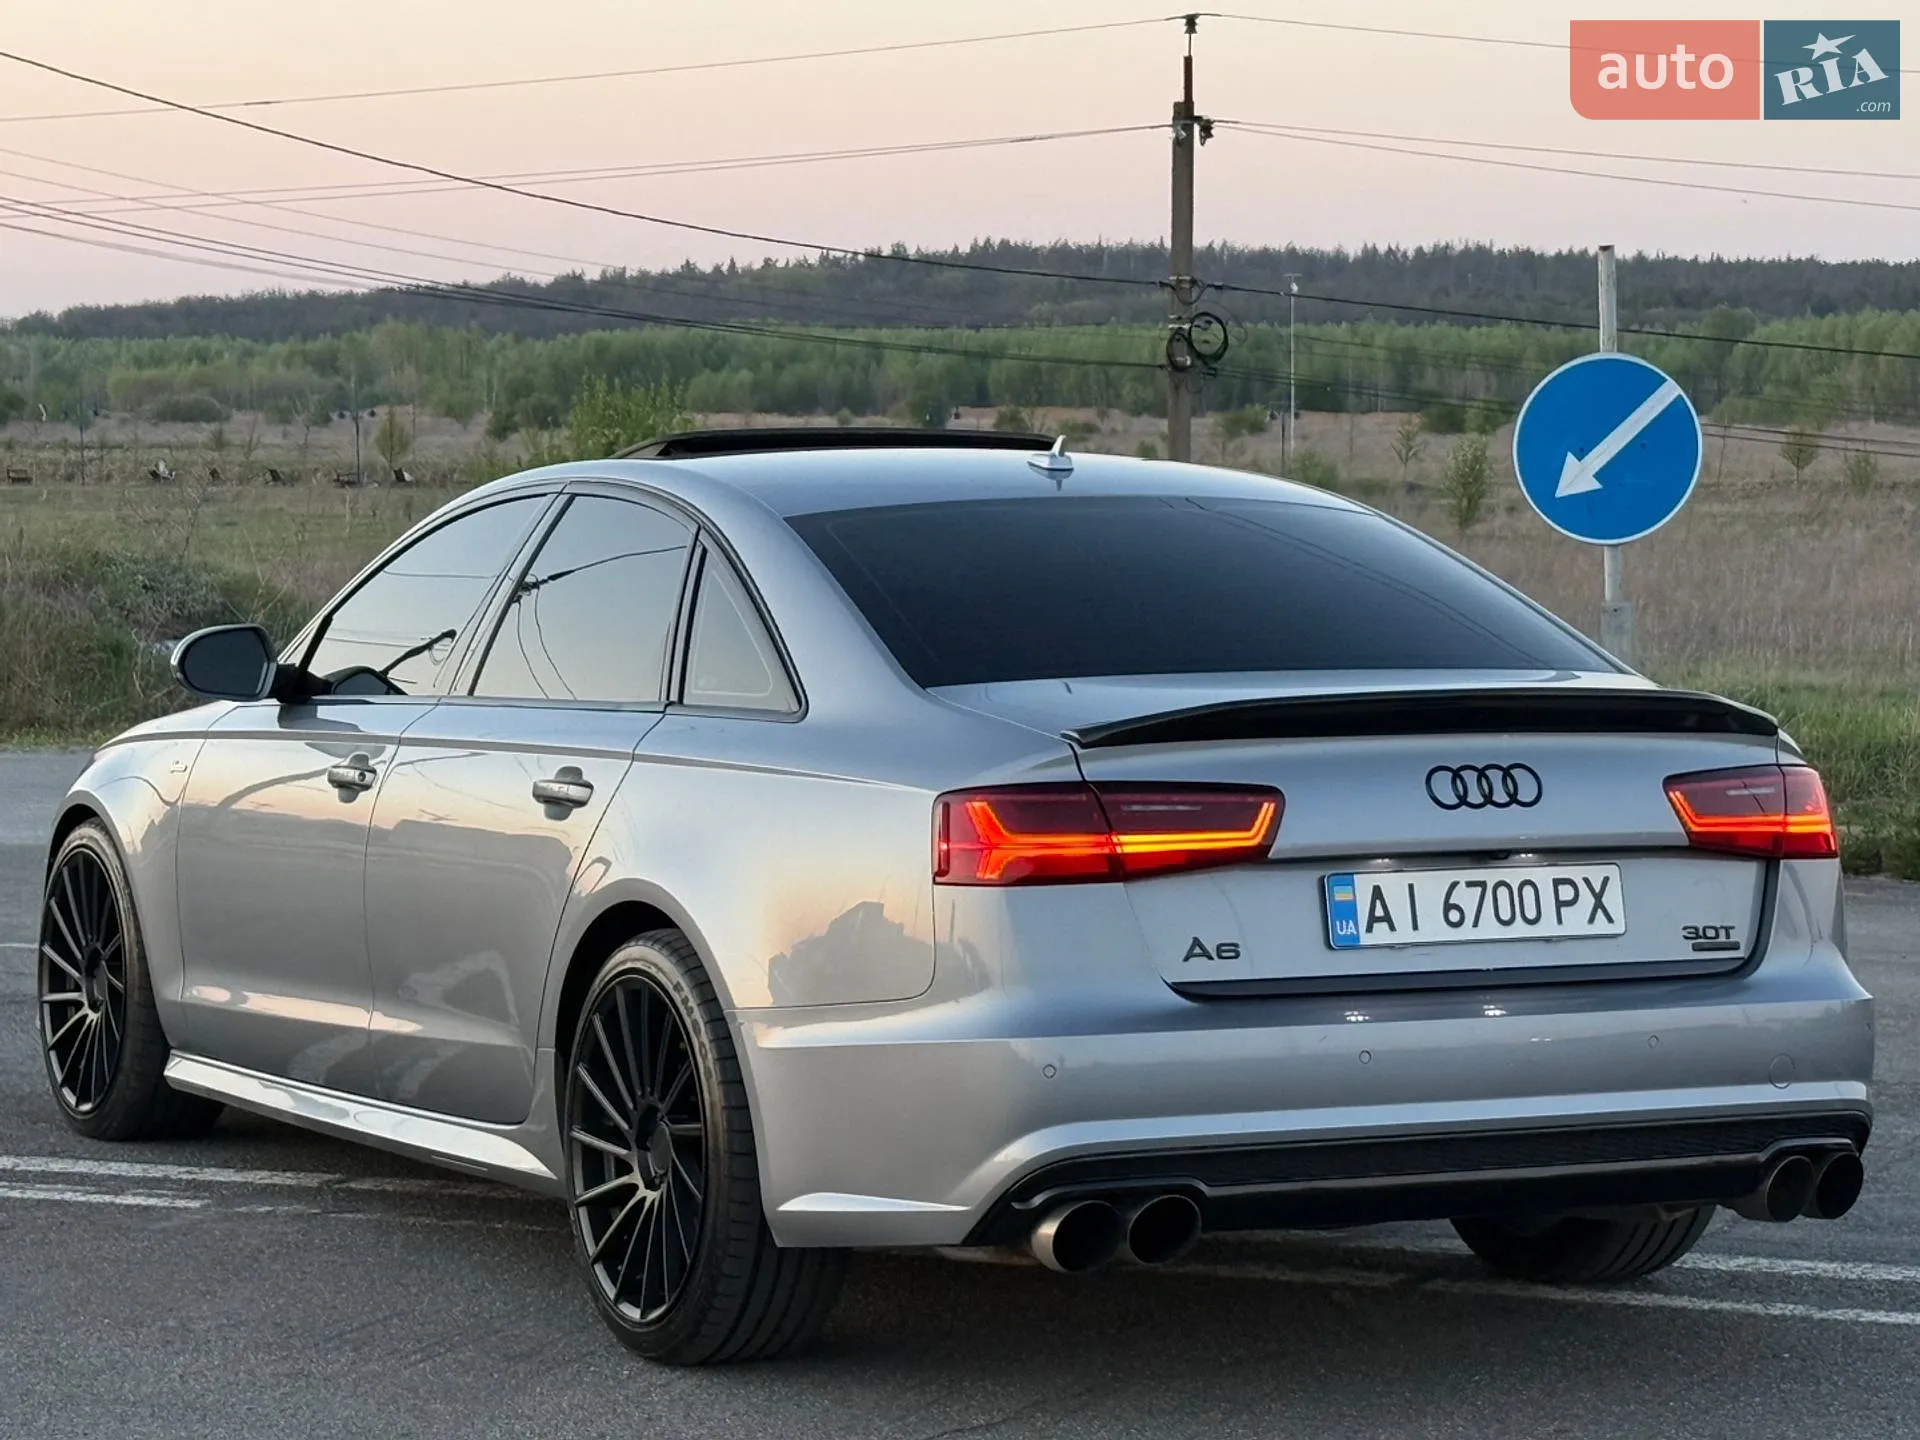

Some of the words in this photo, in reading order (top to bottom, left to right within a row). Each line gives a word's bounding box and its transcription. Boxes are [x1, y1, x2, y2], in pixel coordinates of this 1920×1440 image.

[1365, 883, 1420, 933] AI
[1442, 878, 1542, 929] 6700
[1551, 875, 1615, 926] PX
[1335, 919, 1358, 935] UA
[1182, 936, 1241, 962] A6
